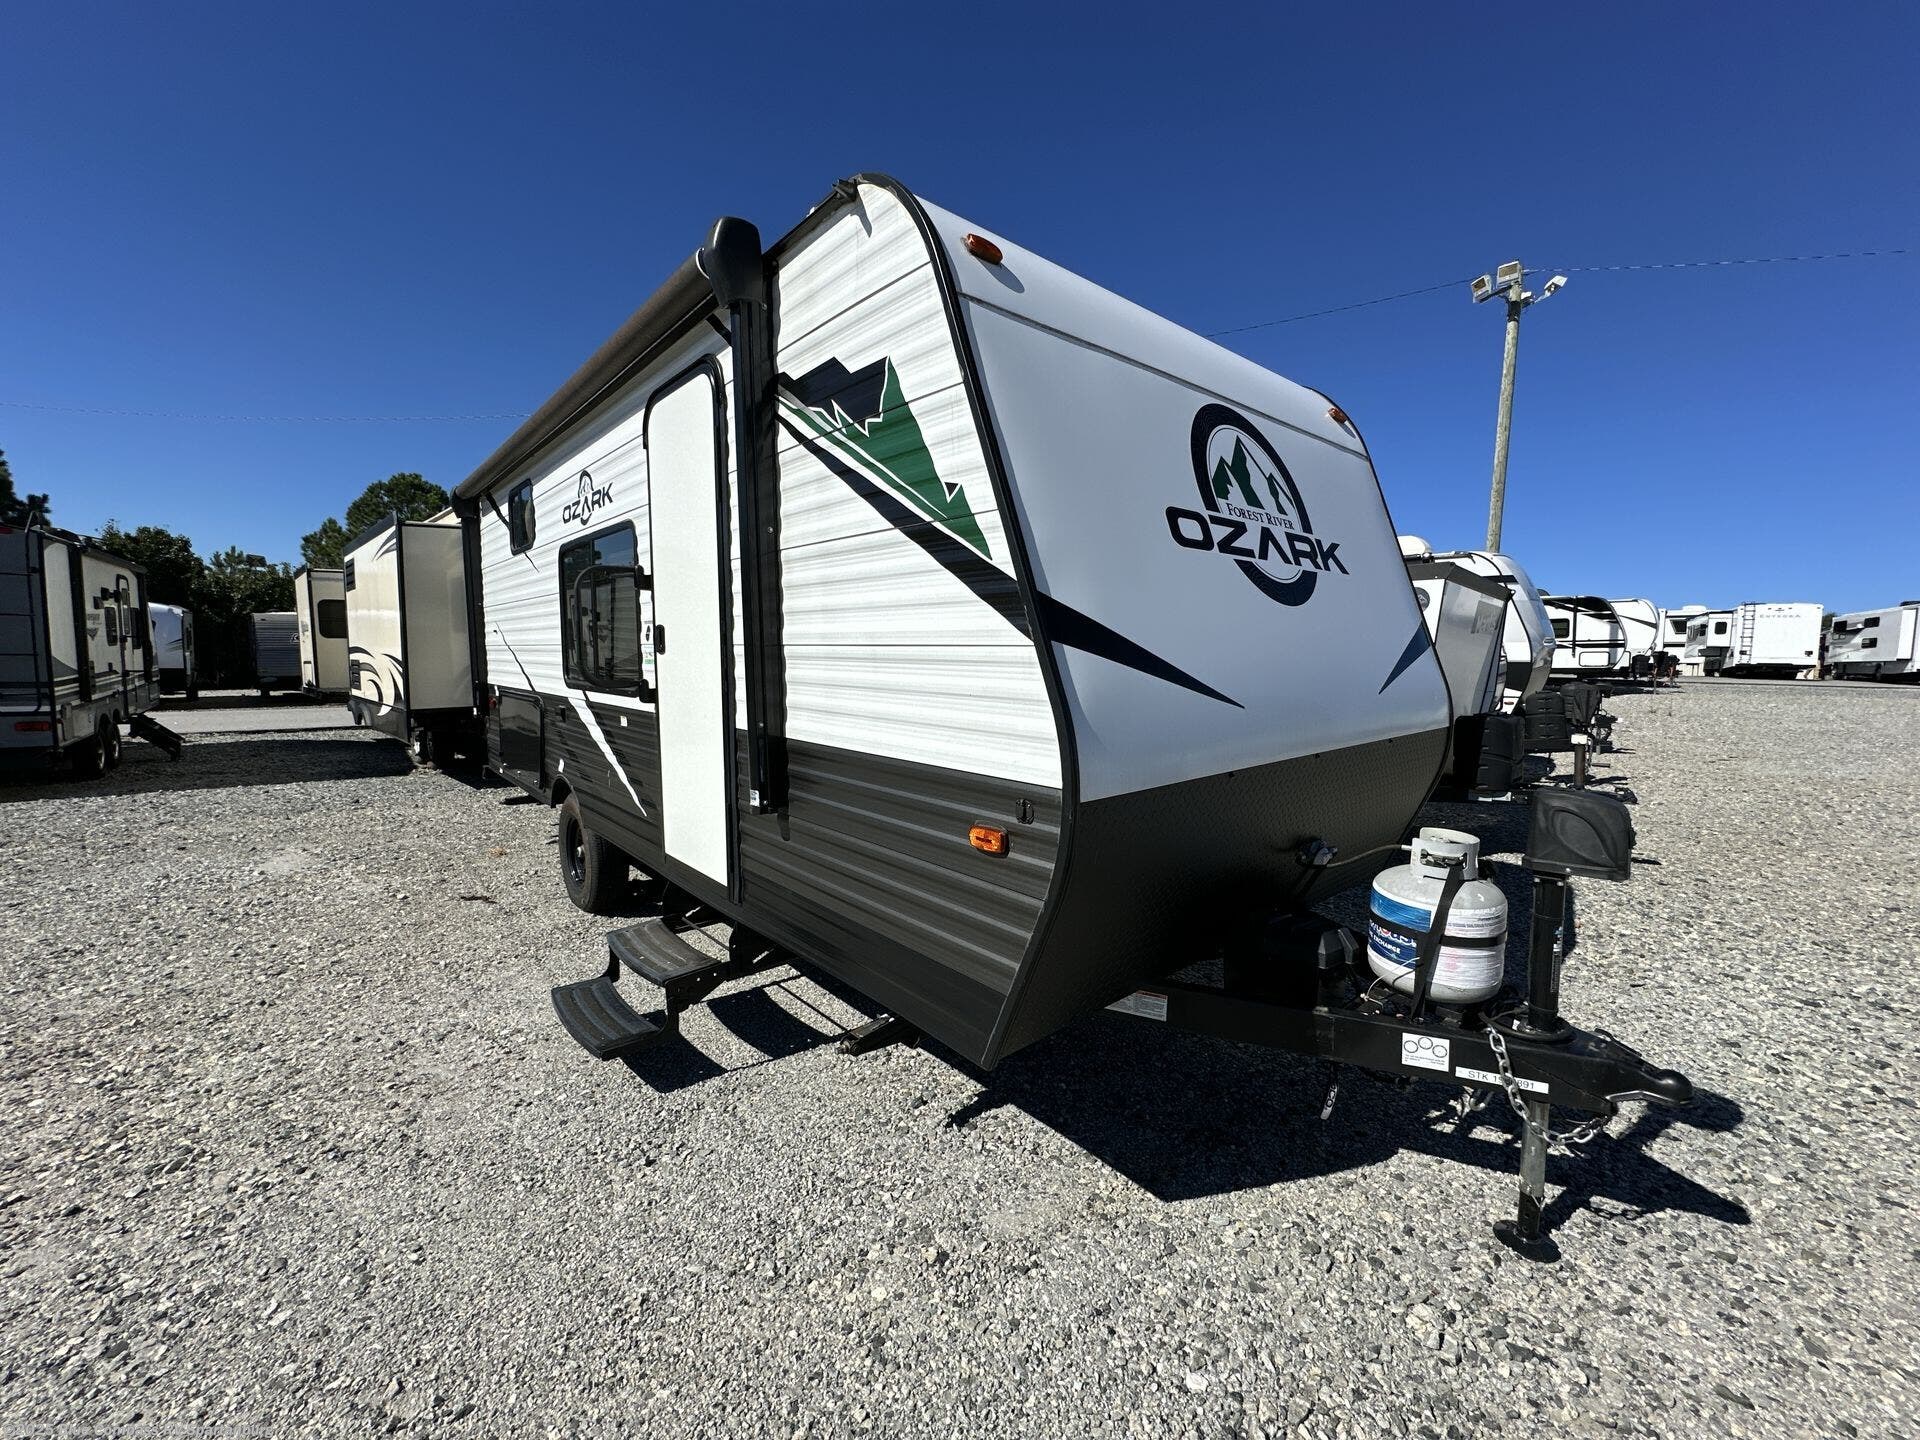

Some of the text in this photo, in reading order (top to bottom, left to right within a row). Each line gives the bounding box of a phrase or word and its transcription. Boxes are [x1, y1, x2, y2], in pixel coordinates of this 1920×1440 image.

[562, 482, 613, 524] OZARK
[1165, 506, 1350, 575] OZARK
[1467, 1070, 1489, 1082] STK
